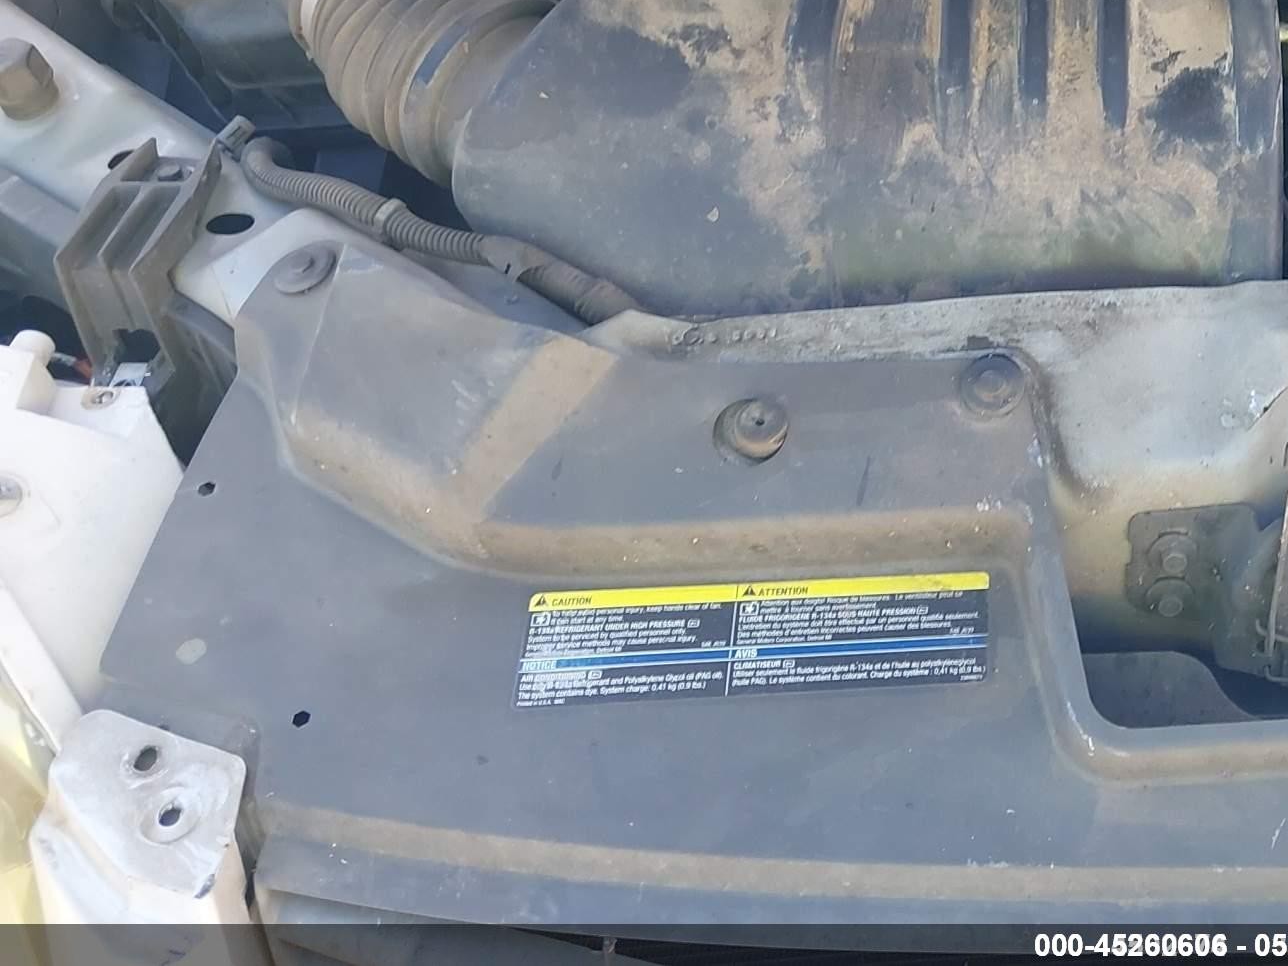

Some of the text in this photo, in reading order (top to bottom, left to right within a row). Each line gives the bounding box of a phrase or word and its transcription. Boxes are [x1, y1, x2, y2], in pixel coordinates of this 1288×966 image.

[758, 586, 808, 596] ATTENTION
[551, 596, 591, 606] CAUTION
[595, 607, 624, 615] personal
[737, 615, 763, 623] FLUIDE
[811, 611, 836, 619] R-134a
[837, 610, 856, 618] SOUS
[857, 609, 880, 617] HAUTE
[881, 607, 915, 615] PRESSION
[888, 615, 919, 623] personnel
[554, 623, 603, 633] REFRIGERANT
[604, 622, 628, 630] UNDER
[629, 621, 648, 629] HIGH
[648, 619, 685, 628] PRESSURE
[751, 629, 783, 637] méthodes
[820, 626, 856, 634] incorrectes
[857, 624, 883, 632] peuvent
[571, 632, 598, 640] serviced
[609, 630, 637, 638] qualified
[638, 629, 671, 637] personnel
[526, 642, 555, 650] Improper
[556, 641, 580, 649] service
[581, 640, 610, 648] methods
[647, 636, 675, 644] personal
[734, 649, 757, 658] AVIS
[521, 660, 557, 670] NOTICE
[732, 669, 754, 678] Utiliser
[755, 667, 788, 676] seulement
[788, 667, 794, 675] le
[796, 666, 814, 674] fluide
[849, 663, 873, 671] R-134a
[874, 662, 881, 670] et
[881, 662, 889, 670] de
[890, 661, 910, 669] l'huile
[910, 660, 919, 668] au
[733, 660, 781, 669] CLIMATISEUR
[520, 674, 533, 682] AIR
[769, 676, 777, 684] Le
[805, 673, 831, 682] contient
[831, 673, 840, 681] du
[869, 670, 892, 679] Charge
[948, 667, 958, 675] kg
[518, 682, 532, 691] Use
[610, 677, 623, 685] and
[694, 672, 711, 680] (PAG
[517, 691, 530, 699] The
[530, 690, 555, 699] system
[555, 688, 584, 697] contains
[599, 686, 624, 695] System
[667, 682, 676, 691] kg
